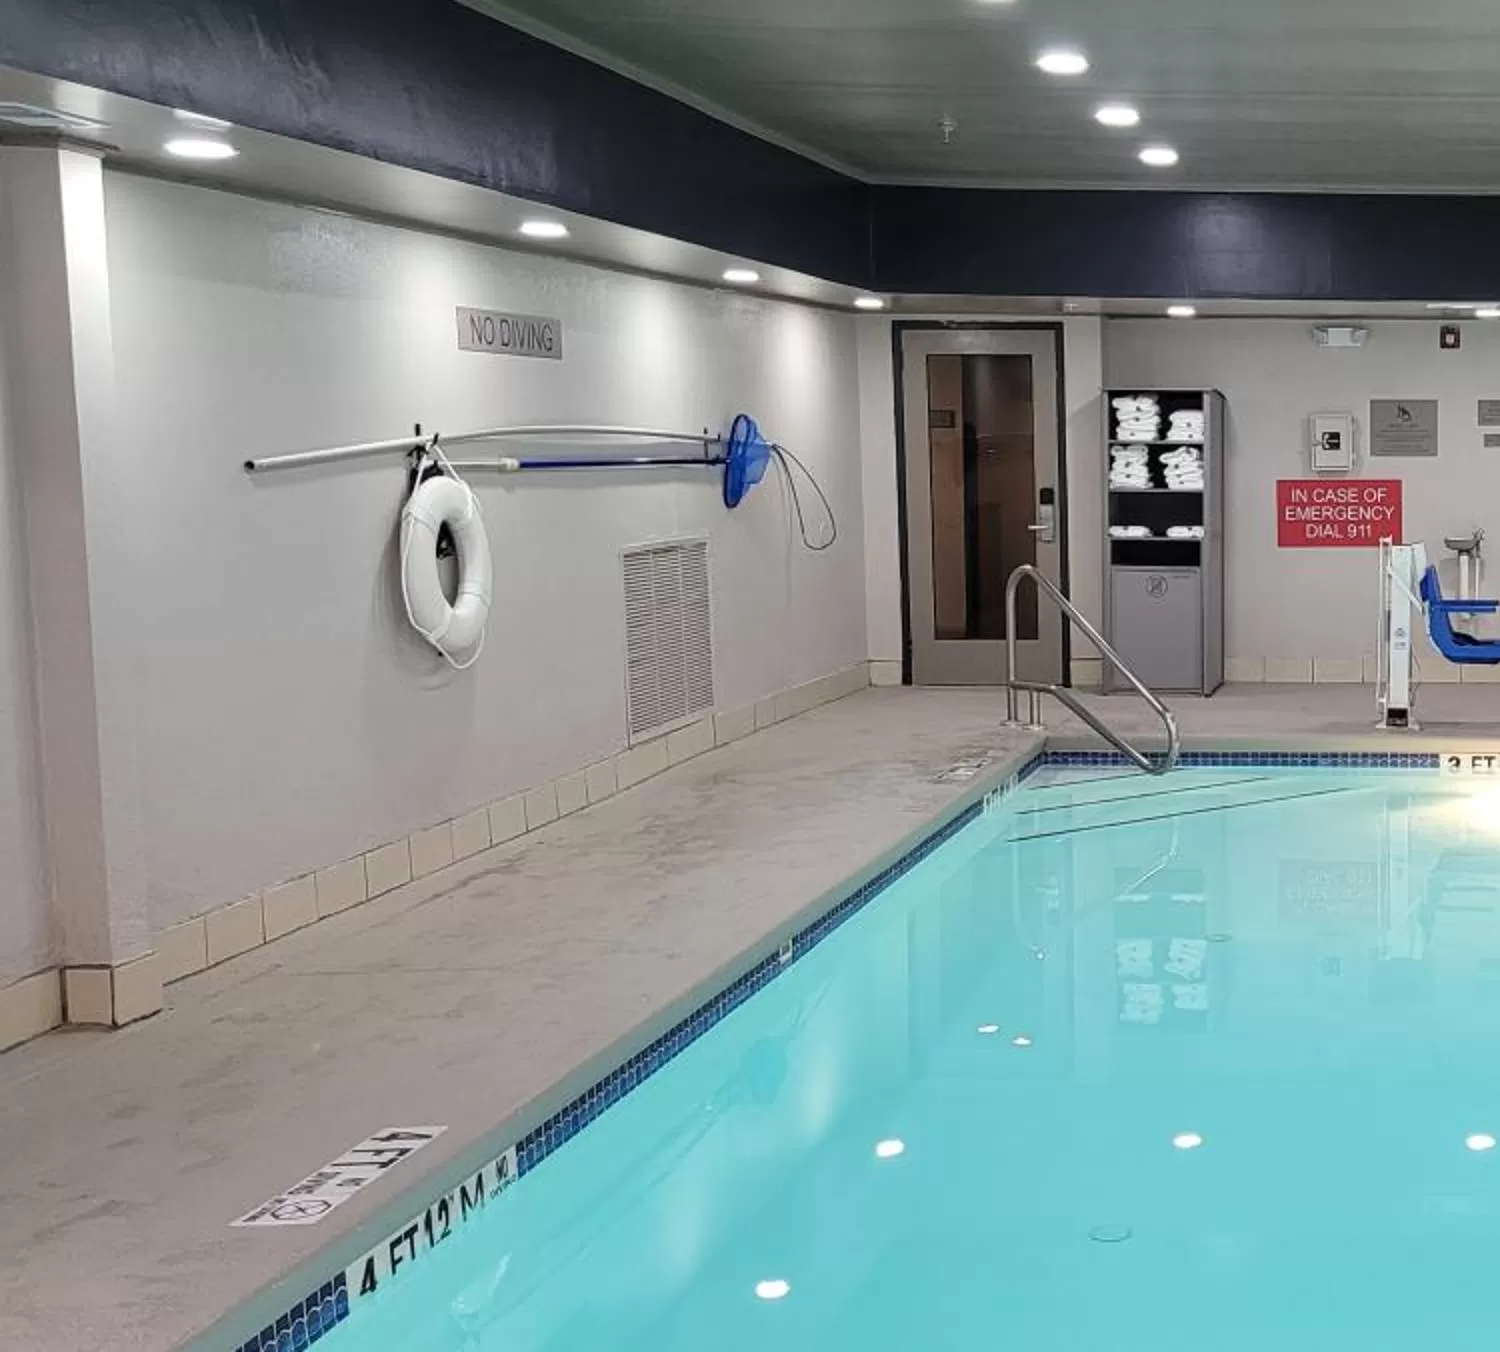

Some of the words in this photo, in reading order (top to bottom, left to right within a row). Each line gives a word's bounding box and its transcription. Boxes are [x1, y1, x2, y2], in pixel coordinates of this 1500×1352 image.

[469, 314, 495, 345] NO
[500, 318, 553, 352] DIVING
[1291, 488, 1308, 503] IN
[1312, 488, 1359, 503] CASE
[1363, 488, 1387, 503] OF
[1285, 506, 1395, 521] EMERGENCY
[1305, 524, 1343, 539] DIAL
[1347, 524, 1372, 538] 911
[1471, 755, 1496, 769] FT
[370, 1131, 433, 1142] 4
[330, 1147, 413, 1170] FT
[360, 1255, 377, 1296] 4
[389, 1223, 419, 1276] FT
[460, 1171, 485, 1222] M
